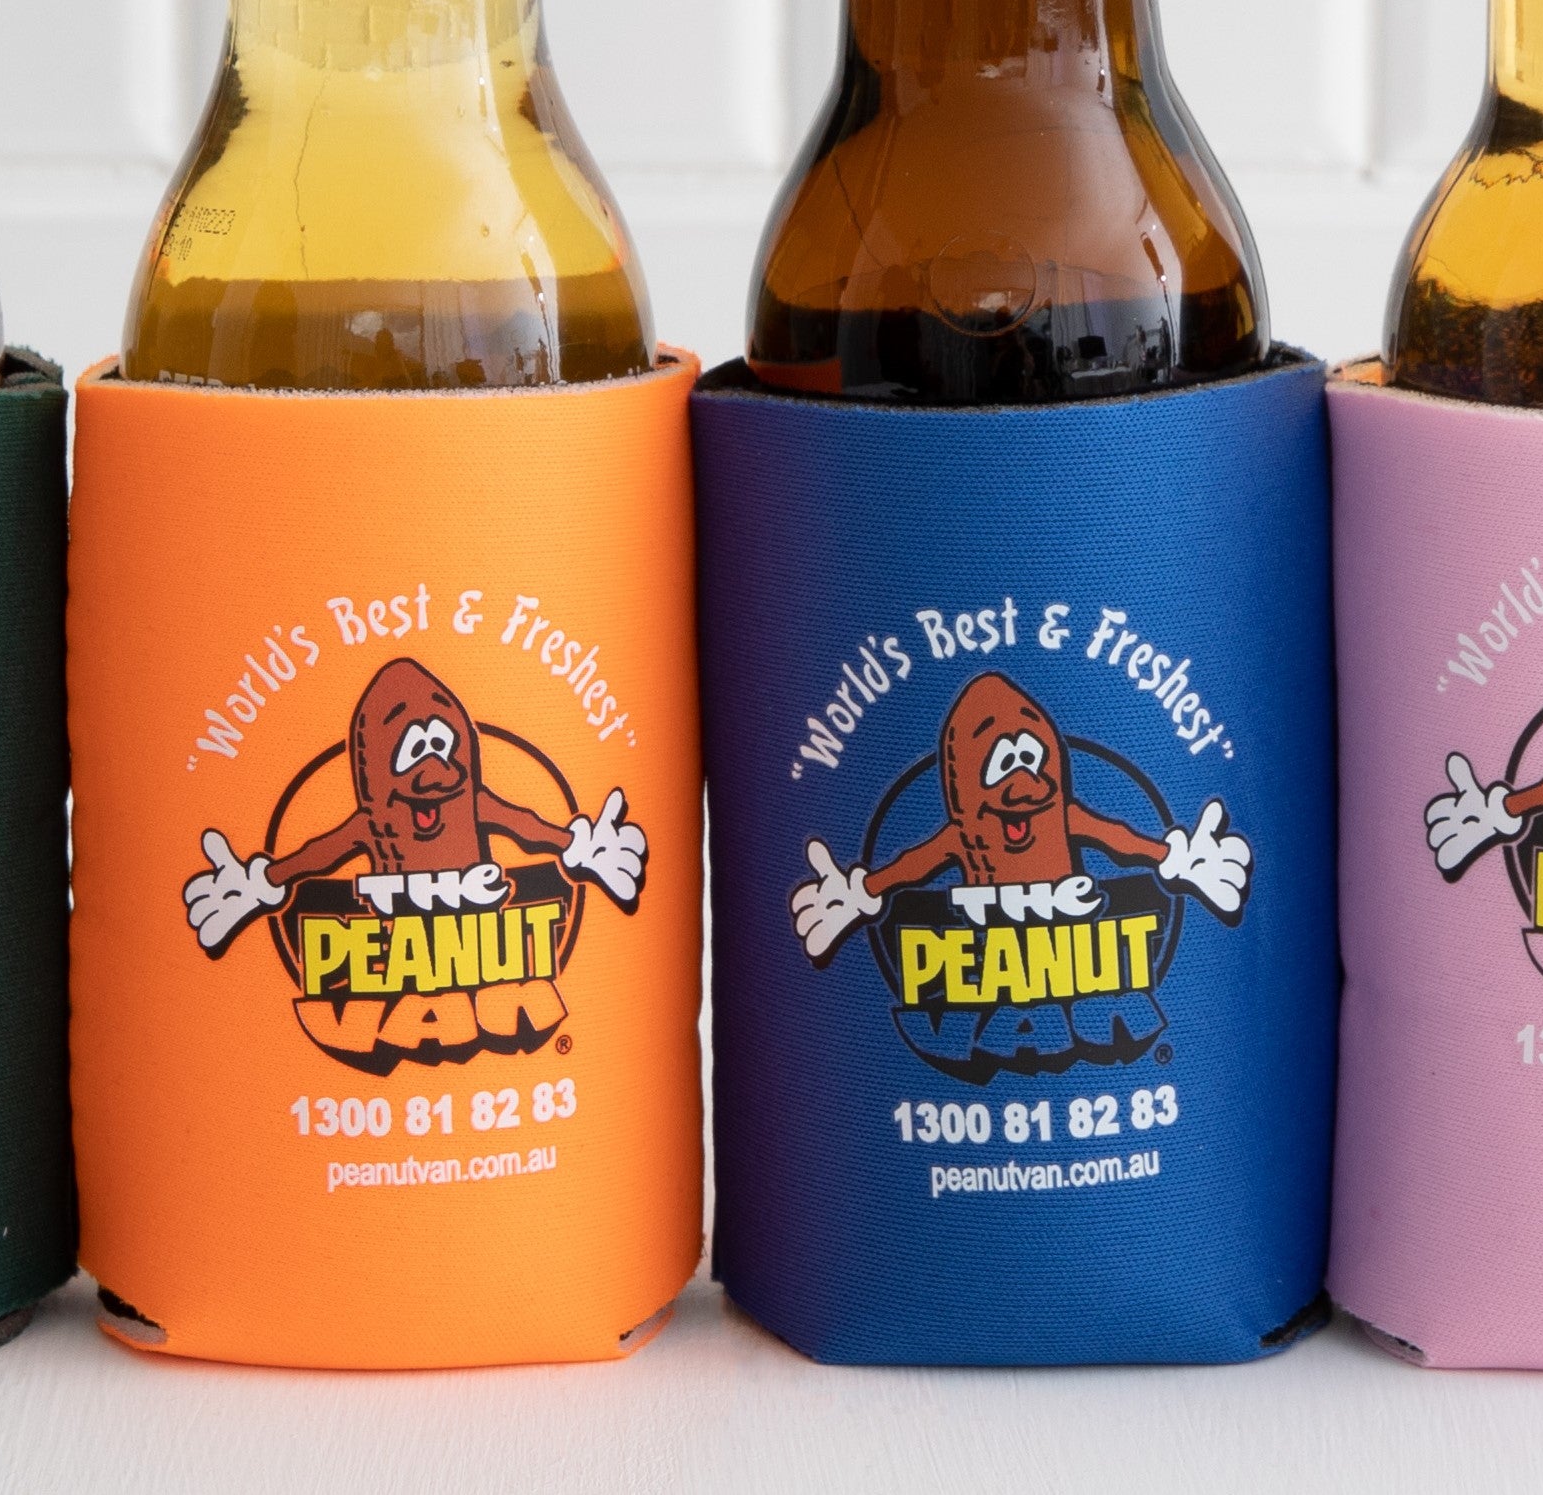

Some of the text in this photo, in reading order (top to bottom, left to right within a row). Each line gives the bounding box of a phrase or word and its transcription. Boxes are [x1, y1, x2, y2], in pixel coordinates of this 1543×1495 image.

[326, 583, 430, 645] Best
[453, 590, 483, 634] &
[915, 597, 1018, 658] Best
[1039, 603, 1070, 649] &
[303, 903, 560, 995] PEANUT
[899, 914, 1157, 1004] PEANUT
[290, 1078, 577, 1137] 1300 81 82 83
[894, 1085, 1178, 1143] 1300 81 82 83
[327, 1146, 556, 1192] peanutvan.com.au
[931, 1150, 1160, 1198] peanutvan.com.au
